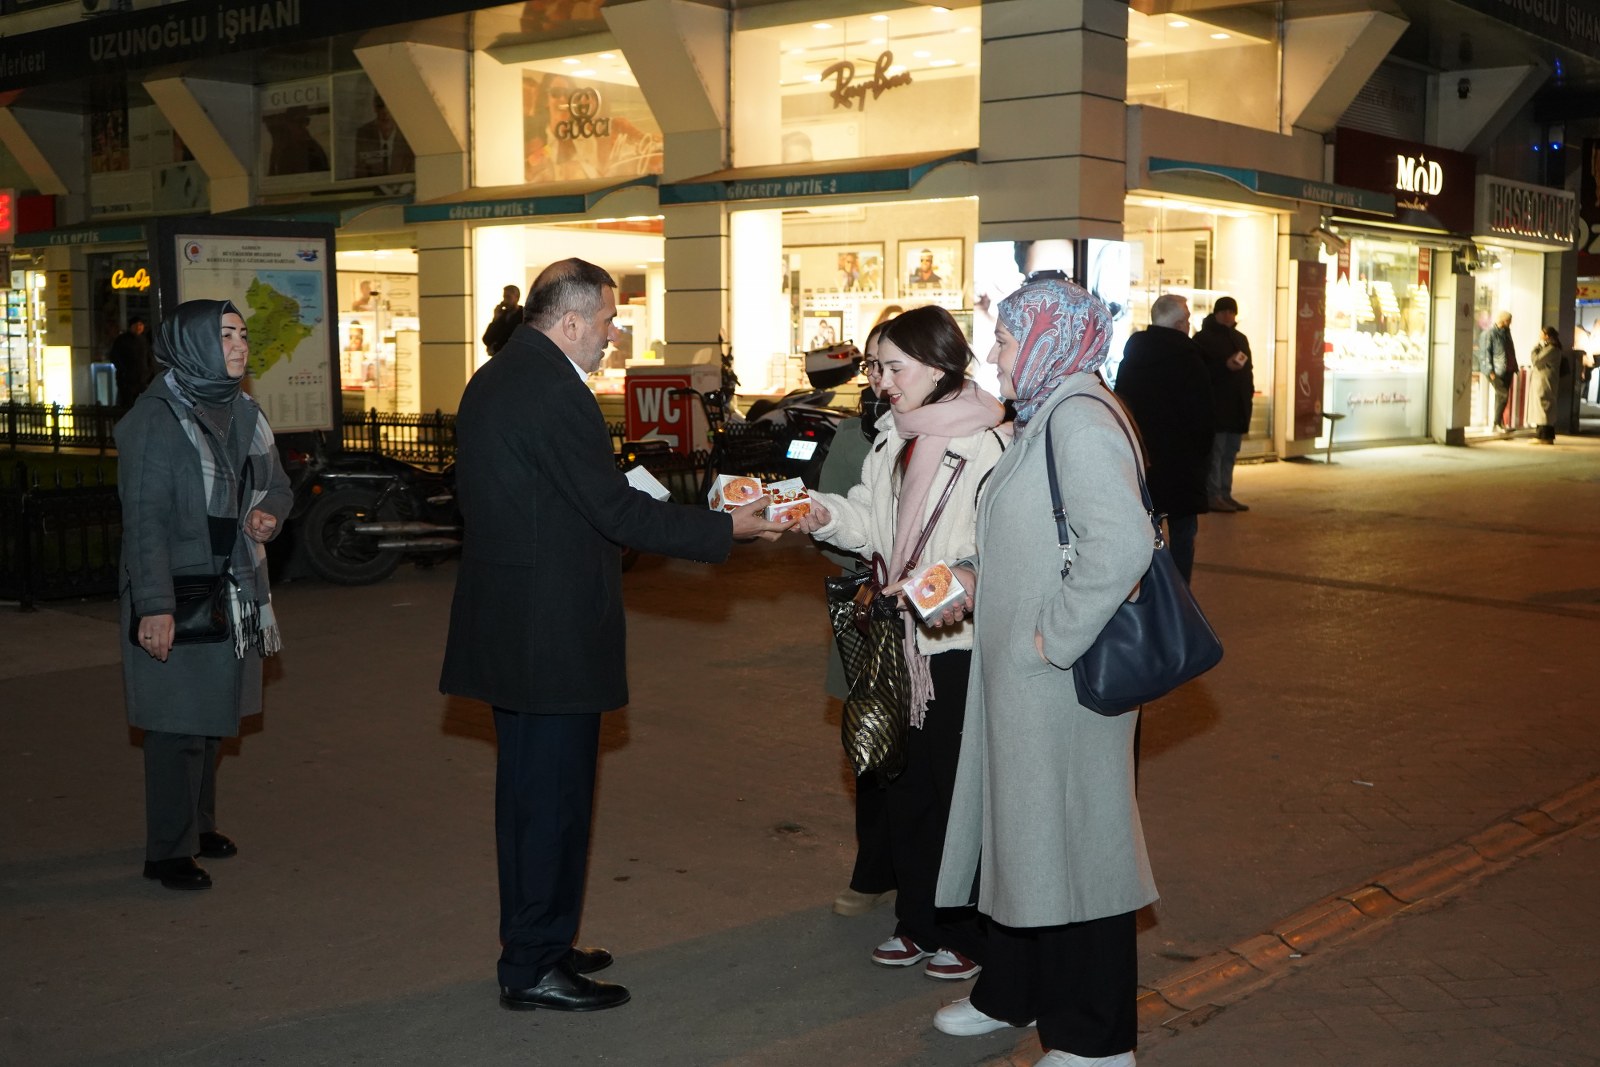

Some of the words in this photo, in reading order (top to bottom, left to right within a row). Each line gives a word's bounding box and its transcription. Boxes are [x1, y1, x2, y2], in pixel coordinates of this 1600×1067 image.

[88, 14, 208, 62] UZUNOĞLU
[217, 0, 300, 44] İŞHANI
[554, 117, 611, 140] GUCCI
[635, 386, 681, 424] WC
